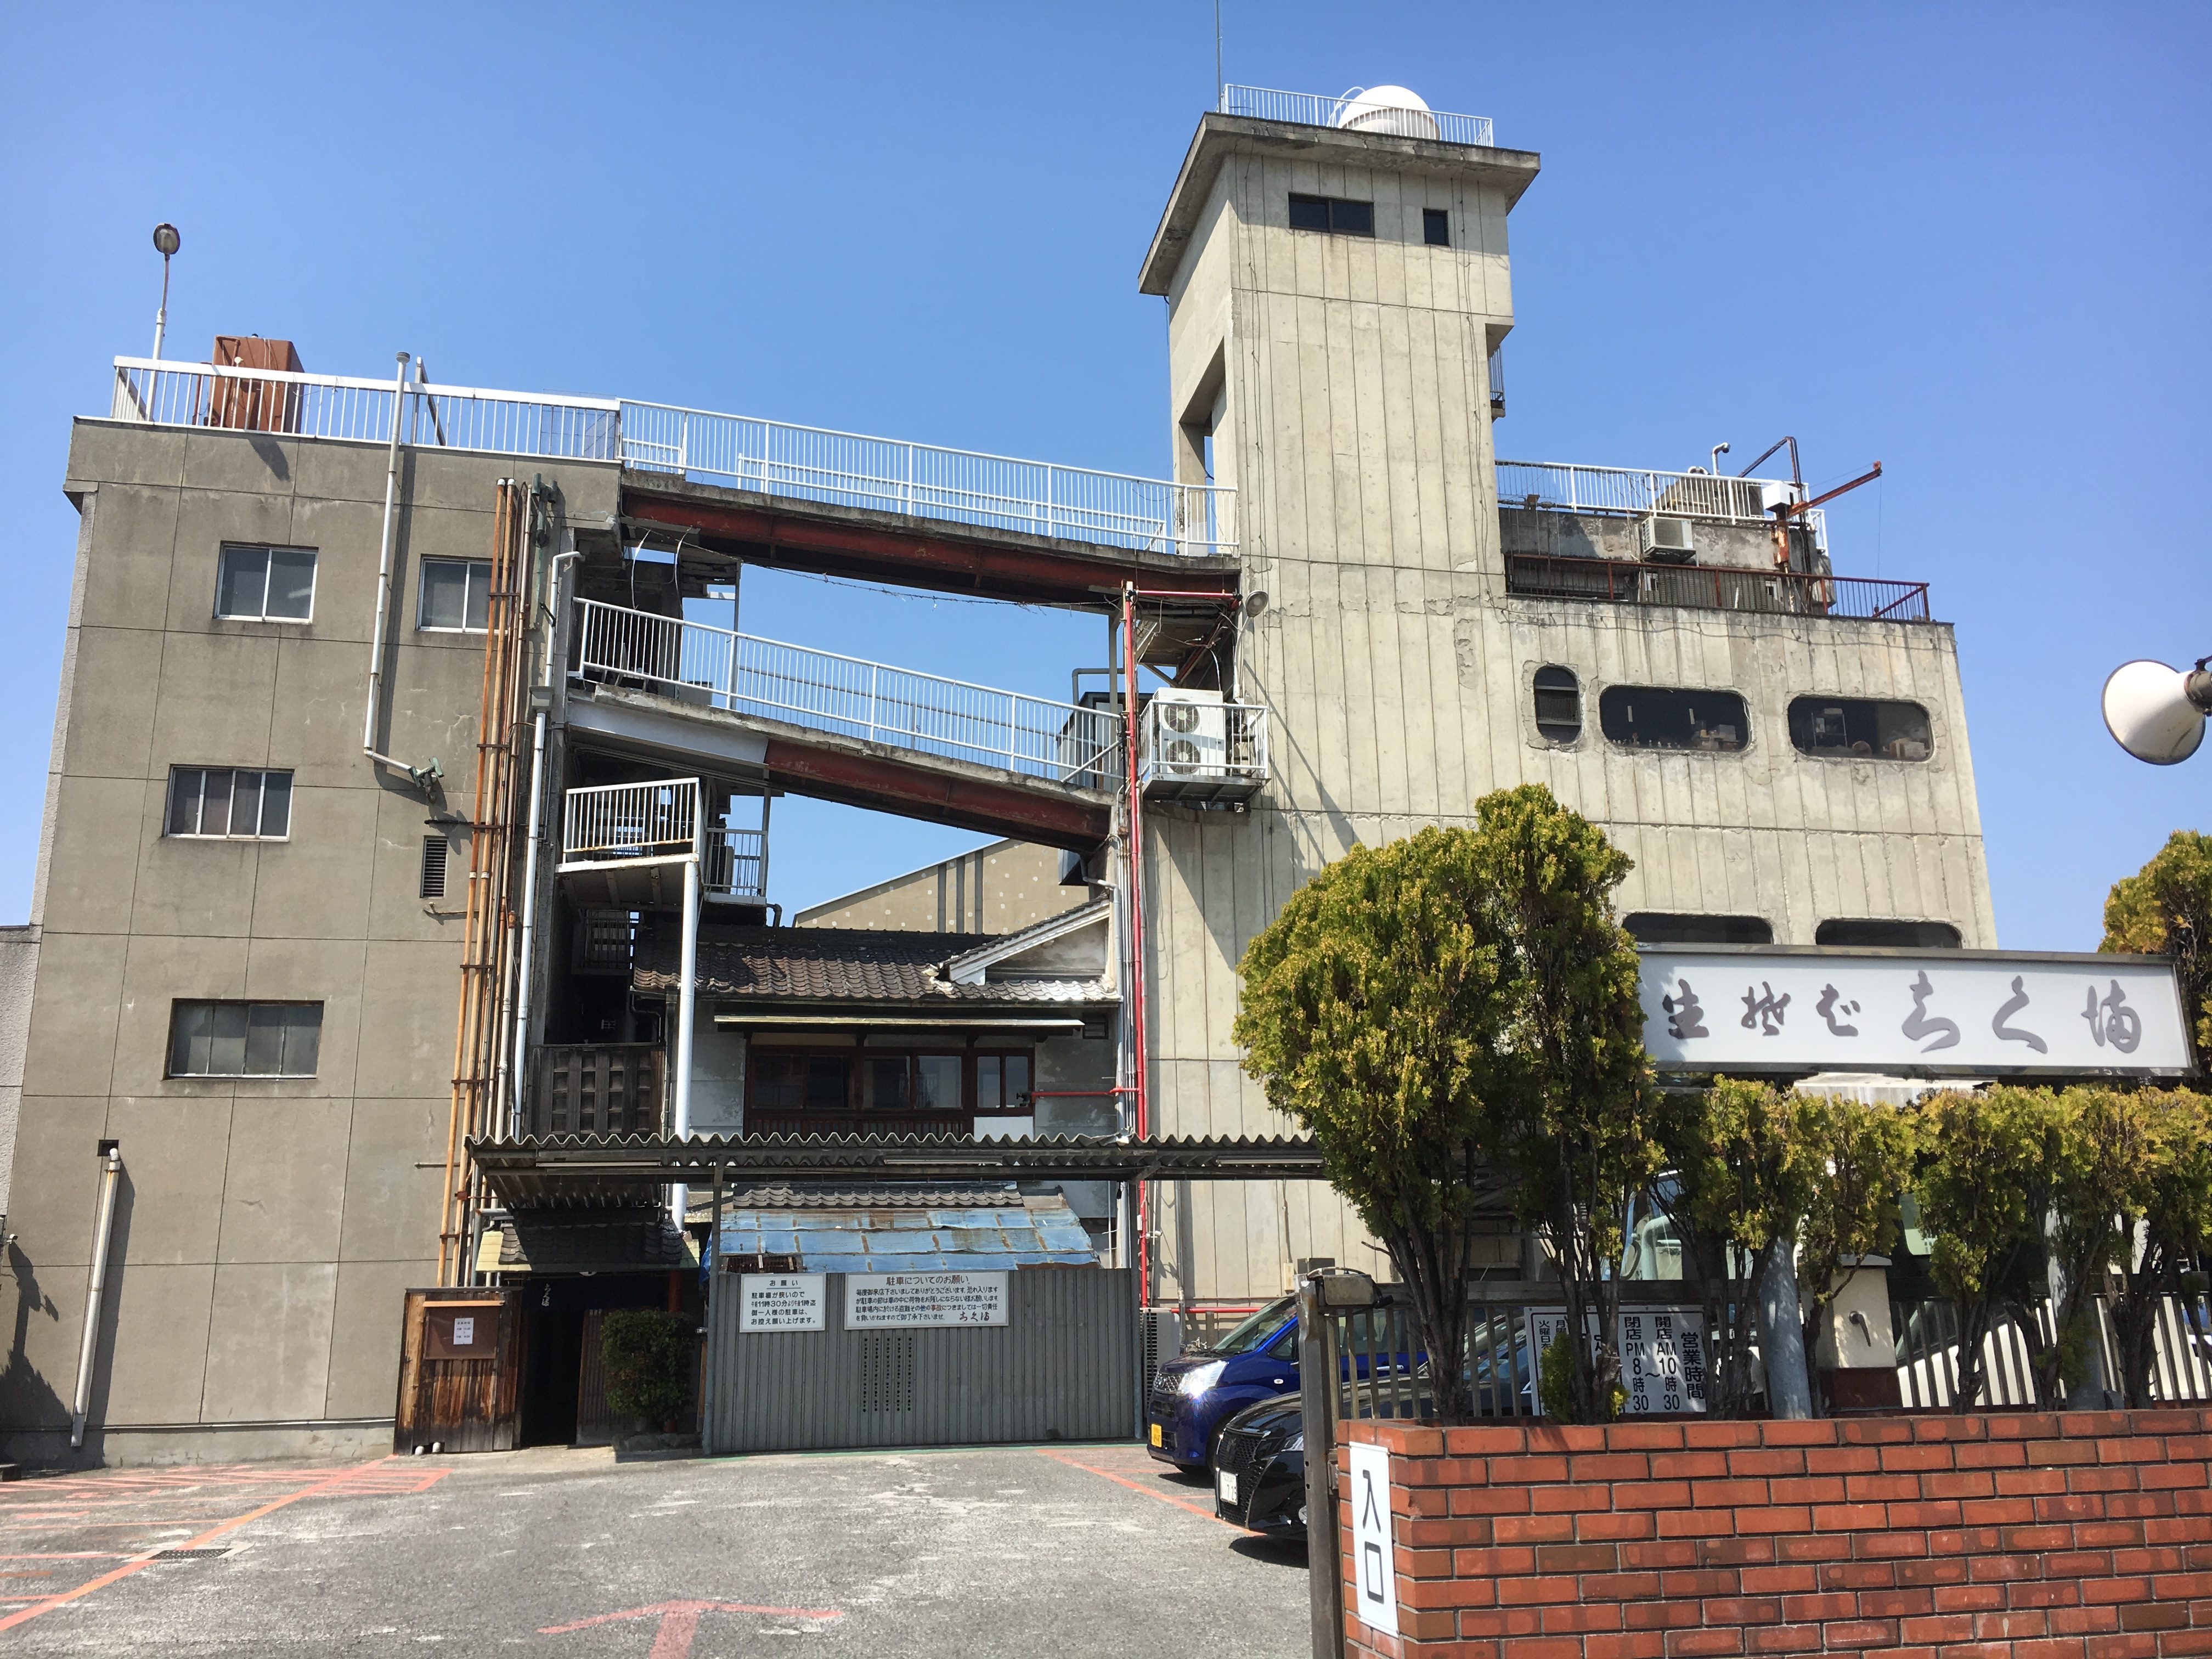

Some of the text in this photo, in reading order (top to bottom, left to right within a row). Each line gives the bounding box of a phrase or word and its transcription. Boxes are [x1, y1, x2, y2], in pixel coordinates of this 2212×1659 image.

[1680, 1332, 1705, 1400] 営業時間
[1362, 1469, 1385, 1604] 入口
